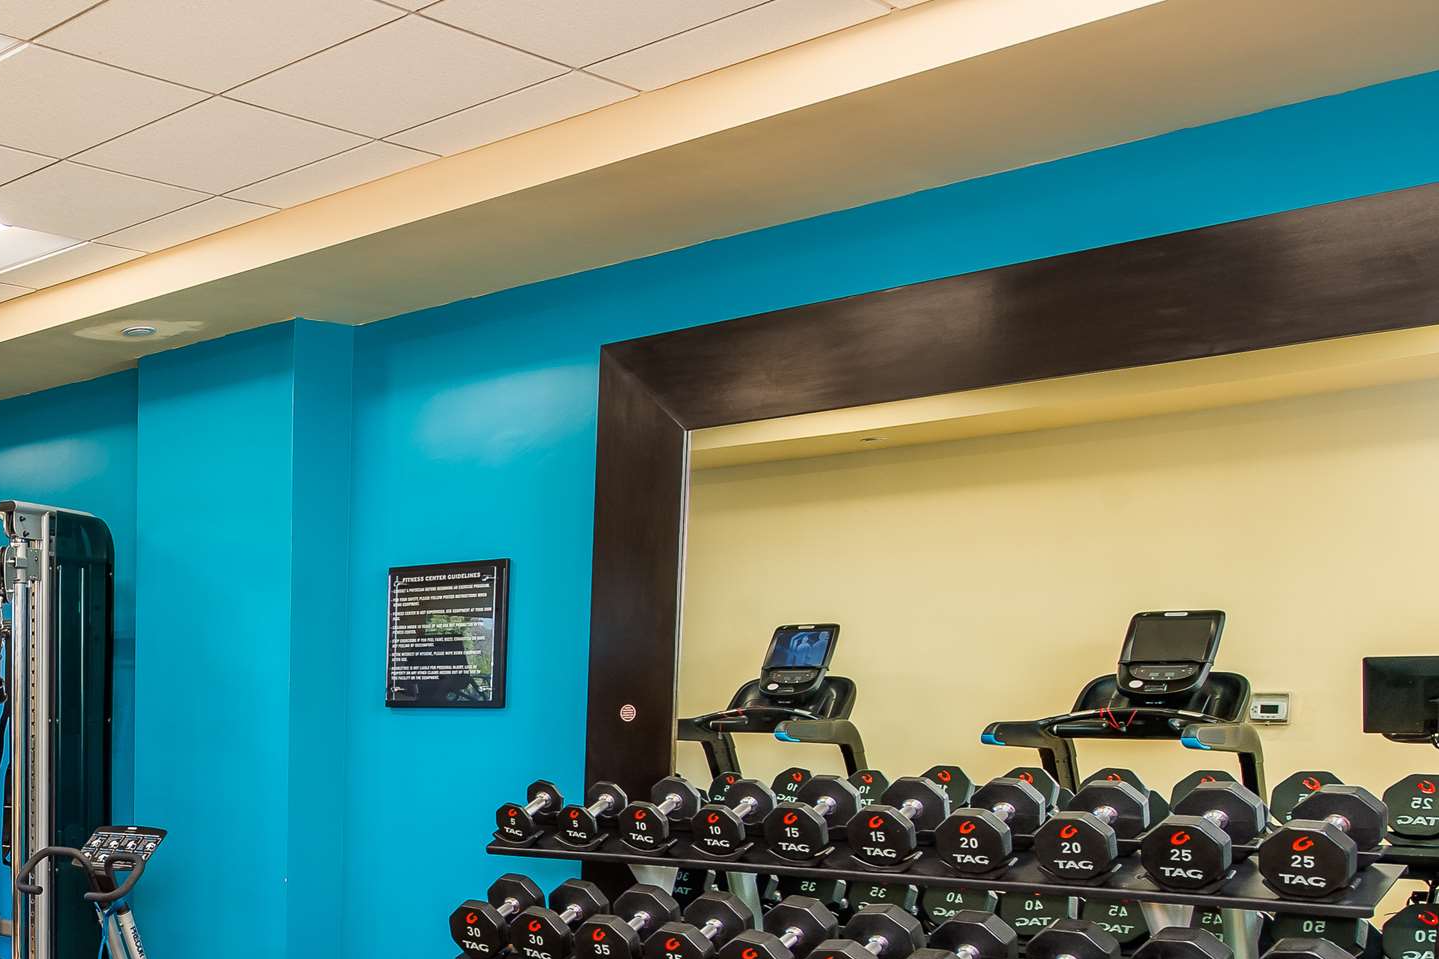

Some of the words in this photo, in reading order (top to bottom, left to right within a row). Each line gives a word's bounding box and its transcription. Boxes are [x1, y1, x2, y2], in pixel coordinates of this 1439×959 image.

[402, 575, 424, 583] FITNESS
[425, 574, 446, 582] CENTER
[447, 572, 481, 580] GUIDELINES
[510, 817, 516, 826] 5
[572, 819, 579, 828] 5
[635, 821, 647, 831] 10
[503, 826, 523, 837] TAG
[566, 829, 587, 839] TAG
[709, 825, 721, 835] 10
[784, 826, 800, 838] 15
[628, 832, 654, 844] TAG
[869, 831, 886, 842] 15
[703, 838, 730, 848] TAG
[777, 841, 810, 853] TAG
[959, 837, 979, 849] 20
[1061, 841, 1082, 854] 20
[862, 846, 897, 858] TAG
[1170, 848, 1192, 862] 25
[952, 853, 990, 865] TAG
[1053, 859, 1094, 871] TAG
[1290, 854, 1315, 869] 25
[1159, 866, 1204, 880] TAG
[1278, 873, 1327, 888] TAG
[466, 926, 481, 938] 30
[528, 933, 544, 946] 30
[462, 939, 490, 953] TAG
[593, 943, 611, 956] 35
